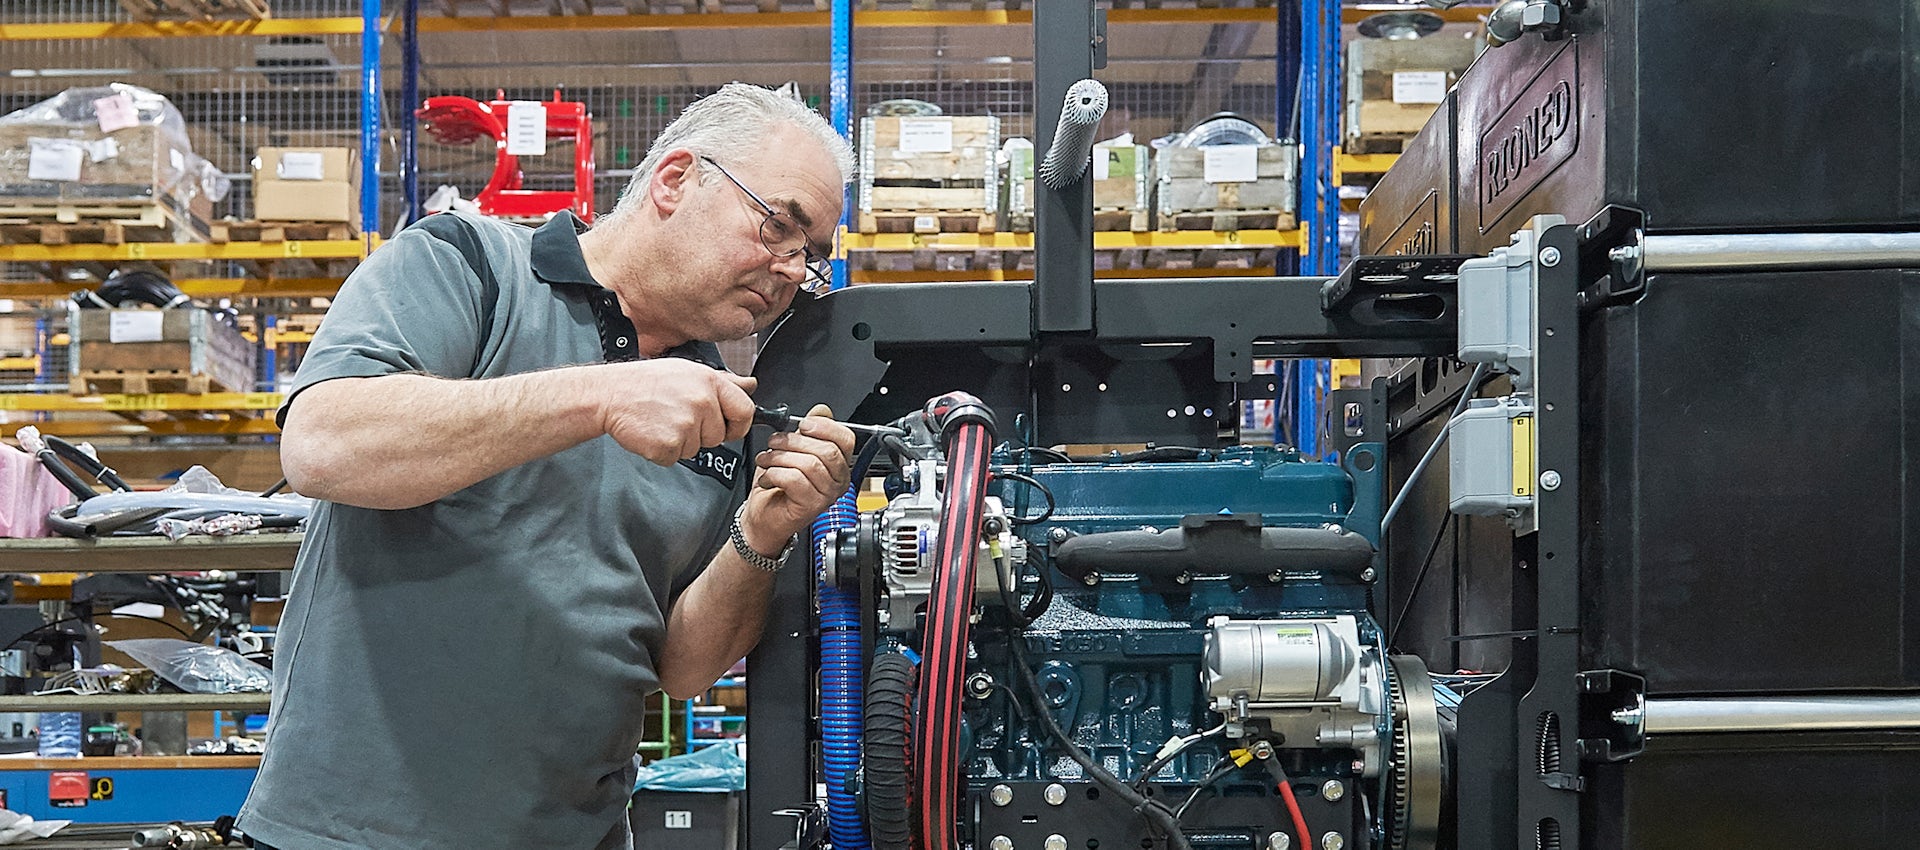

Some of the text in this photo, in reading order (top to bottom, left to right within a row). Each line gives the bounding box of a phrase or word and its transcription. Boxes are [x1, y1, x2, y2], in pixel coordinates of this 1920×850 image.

[1487, 80, 1571, 204] RIONED
[690, 451, 738, 480] ned
[667, 813, 686, 826] 11
